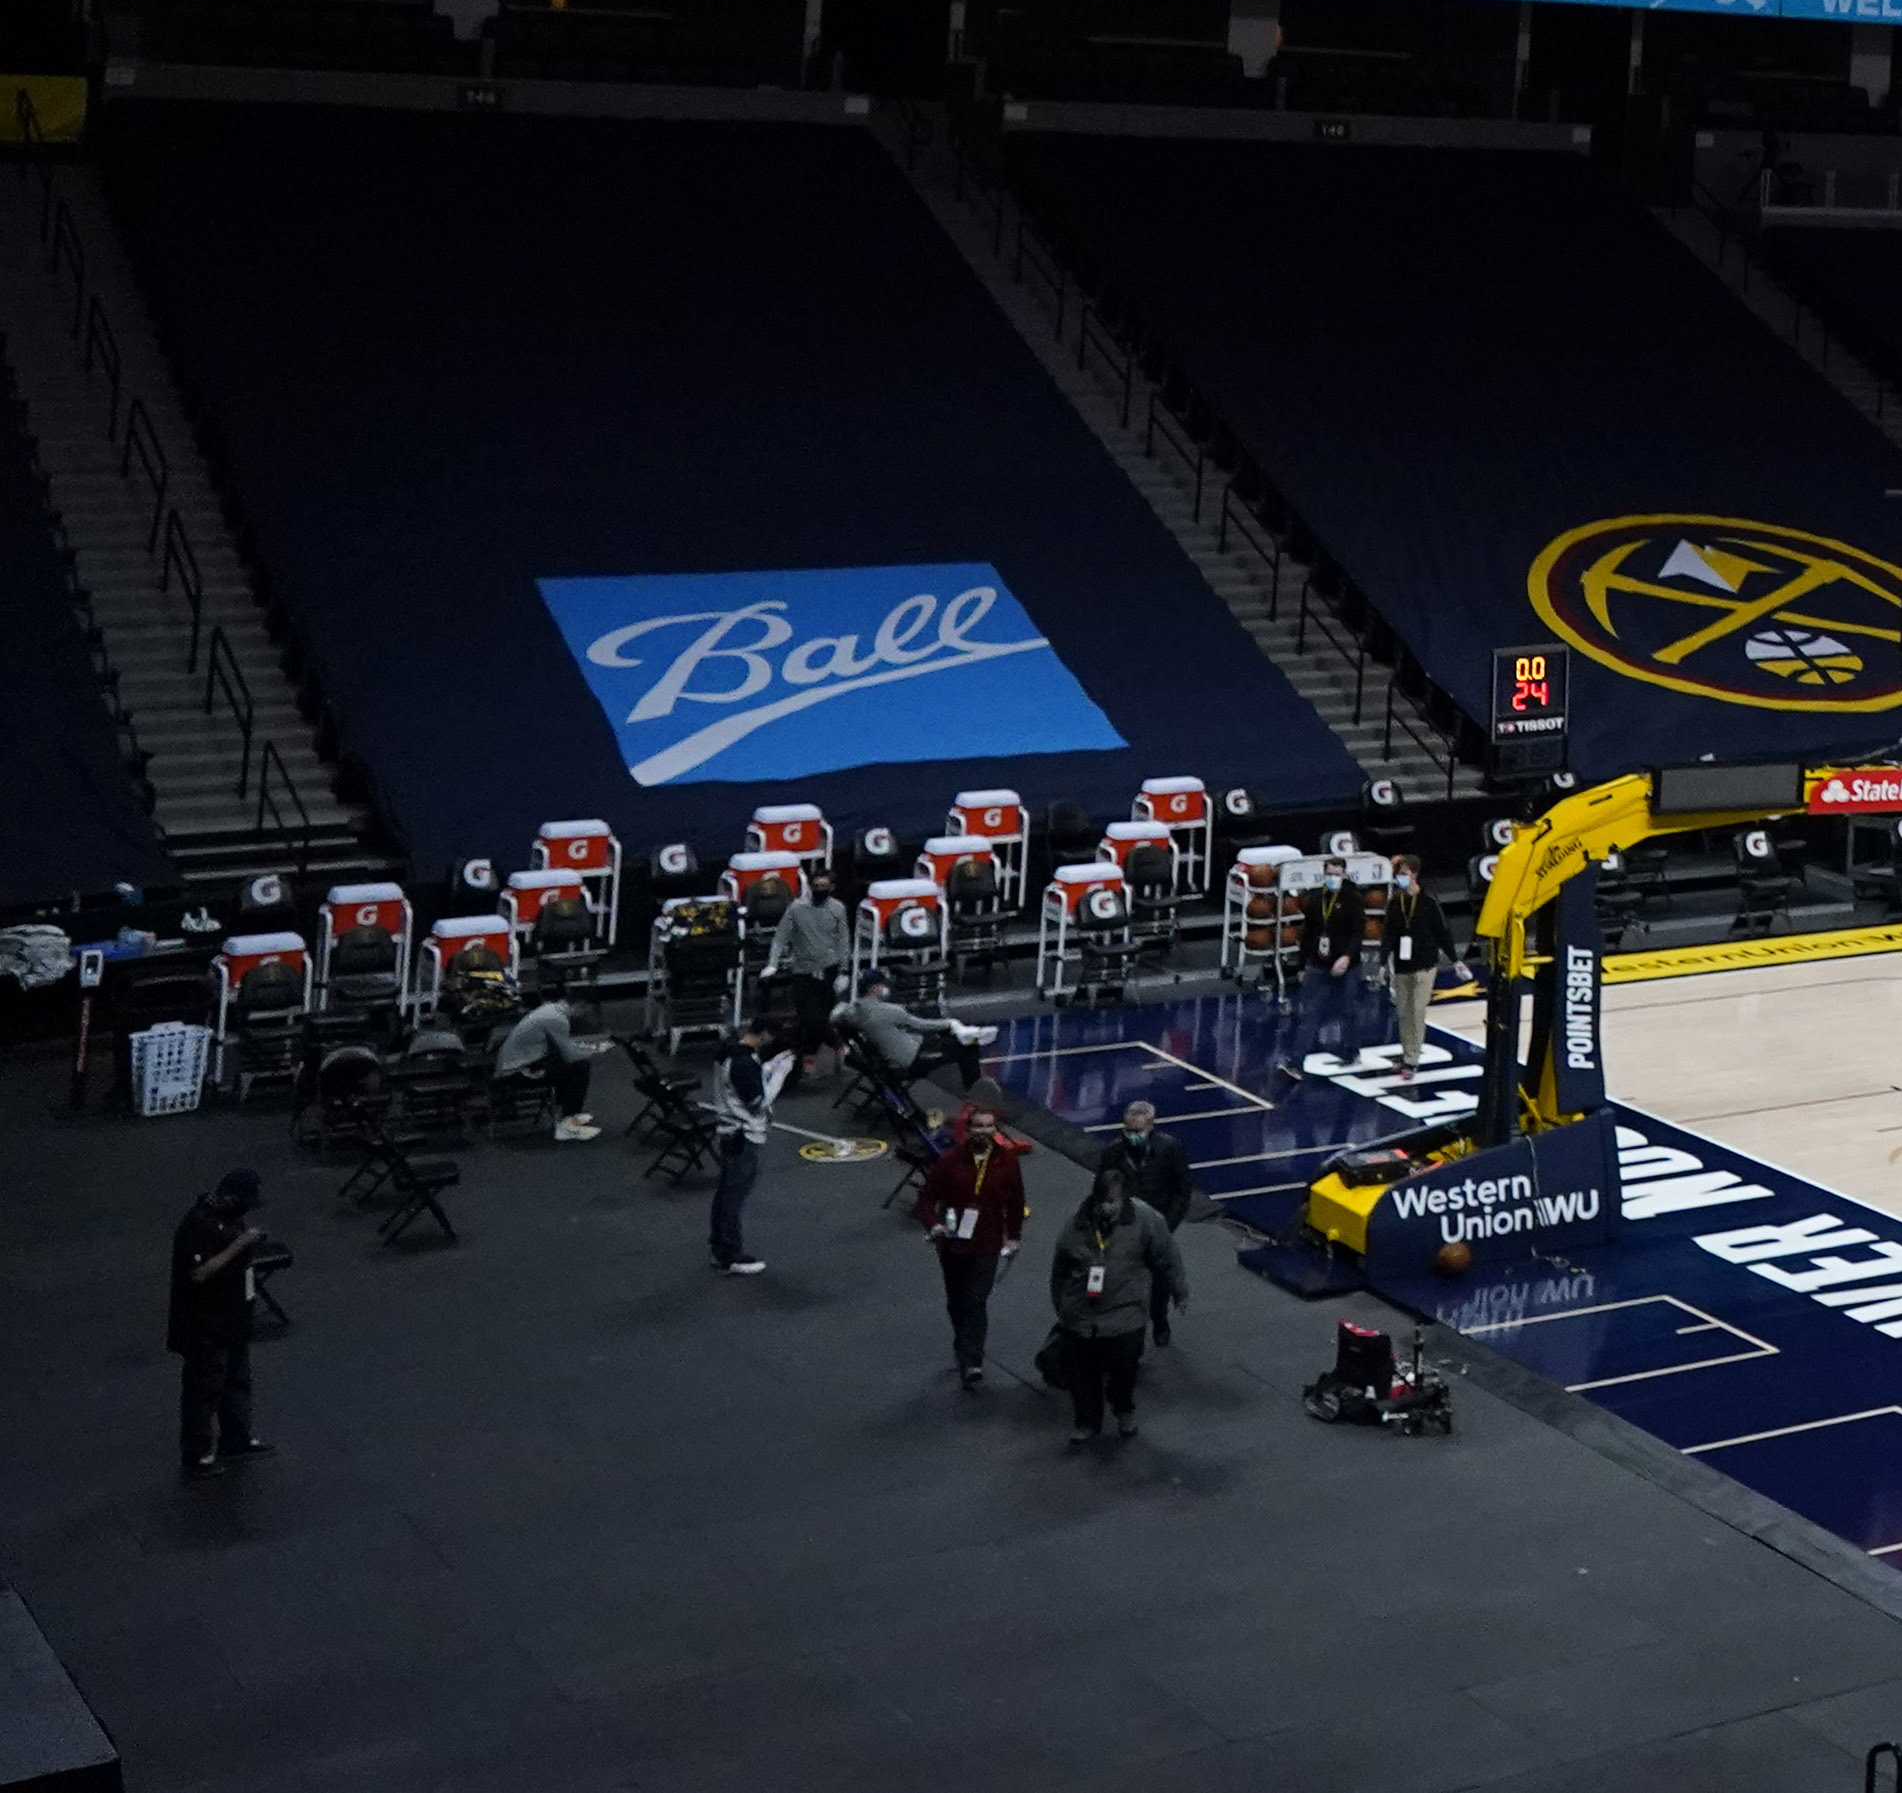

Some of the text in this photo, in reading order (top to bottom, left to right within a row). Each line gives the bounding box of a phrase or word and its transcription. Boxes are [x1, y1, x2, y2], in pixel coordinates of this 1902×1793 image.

[586, 585, 1049, 753] Ball
[1515, 655, 1547, 681] 0.0
[1512, 682, 1550, 711] 24
[1566, 943, 1595, 1070] POINTSBET
[1392, 1174, 1533, 1220] Western
[1440, 1208, 1534, 1245] Union
